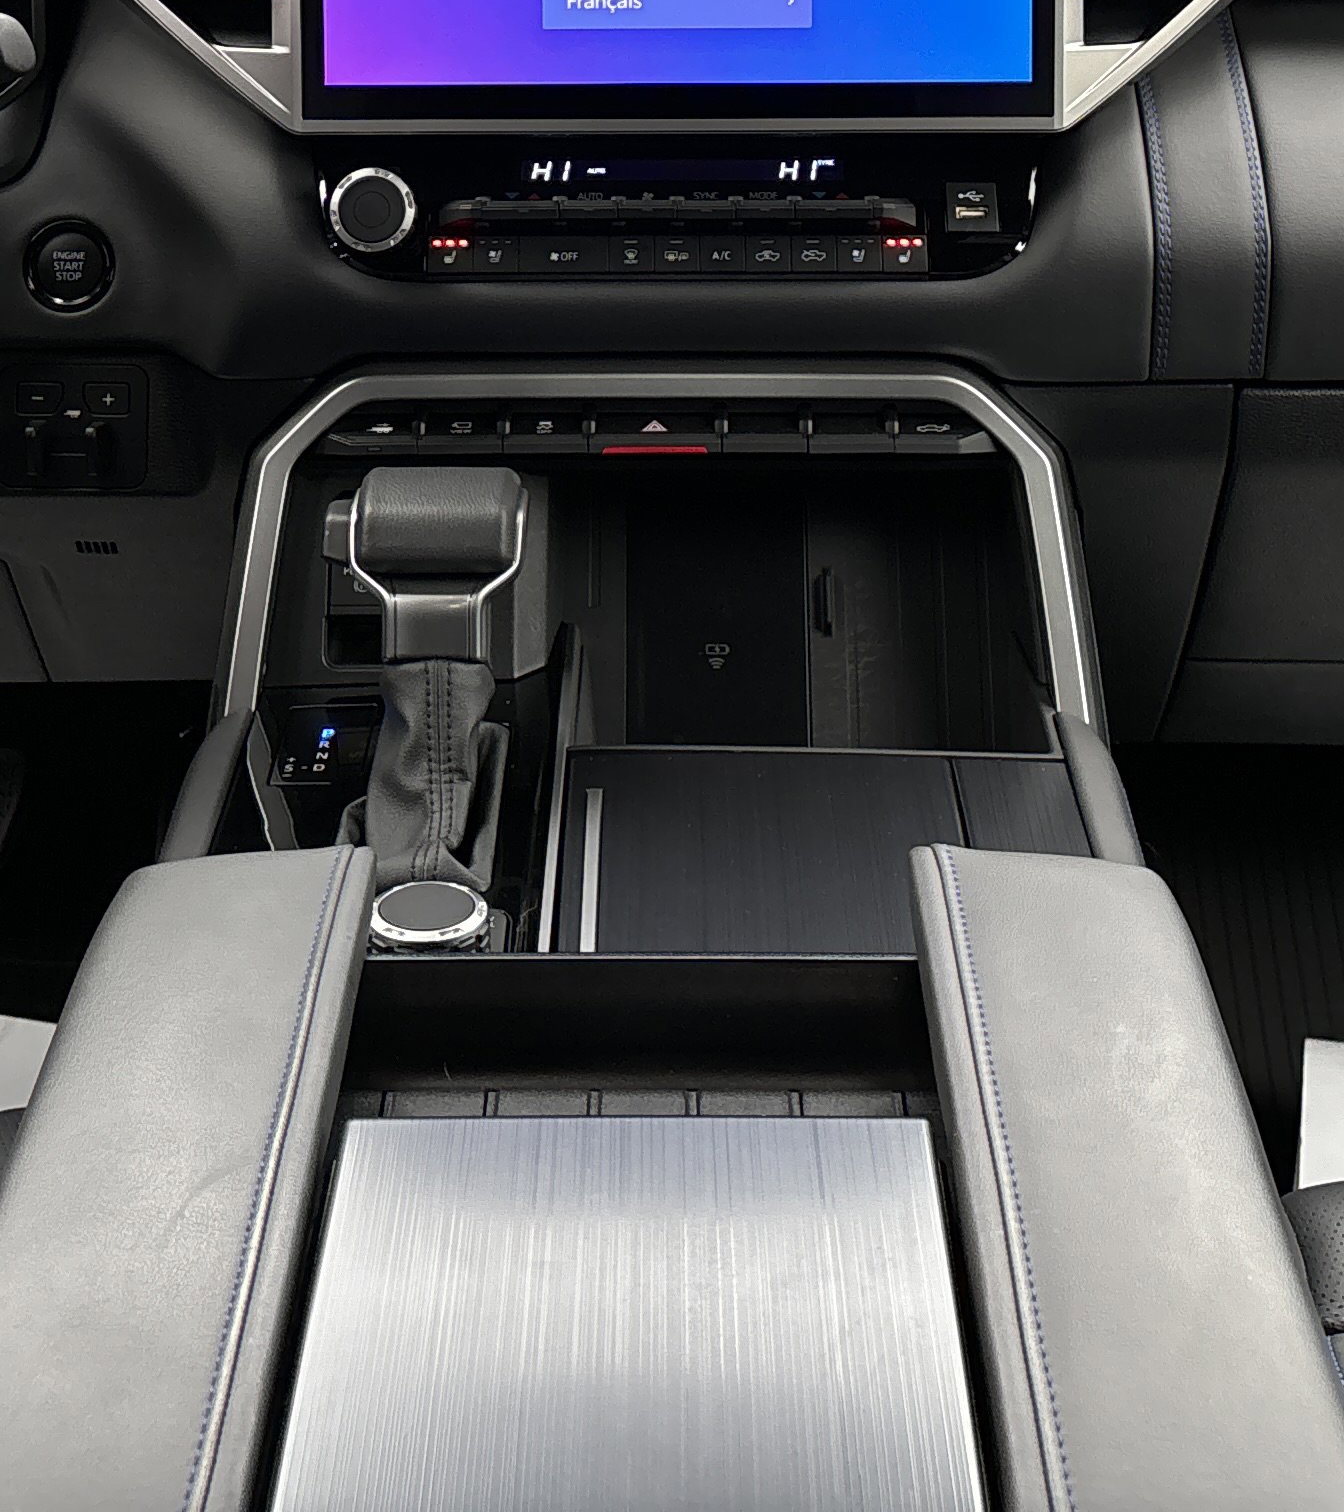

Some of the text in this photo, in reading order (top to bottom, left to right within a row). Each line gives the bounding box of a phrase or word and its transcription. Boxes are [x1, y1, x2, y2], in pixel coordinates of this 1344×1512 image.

[530, 160, 571, 182] HI
[577, 191, 604, 201] AUTO
[693, 191, 719, 200] SYNC
[749, 191, 778, 200] MODE
[52, 251, 86, 260] ENGINE
[560, 251, 579, 261] OFF
[712, 251, 732, 261] A/C
[54, 261, 84, 271] START
[56, 271, 82, 281] STOP
[321, 728, 335, 740] P
[318, 740, 331, 749] R
[316, 751, 329, 760] N
[283, 763, 295, 773] S
[312, 763, 326, 772] D
